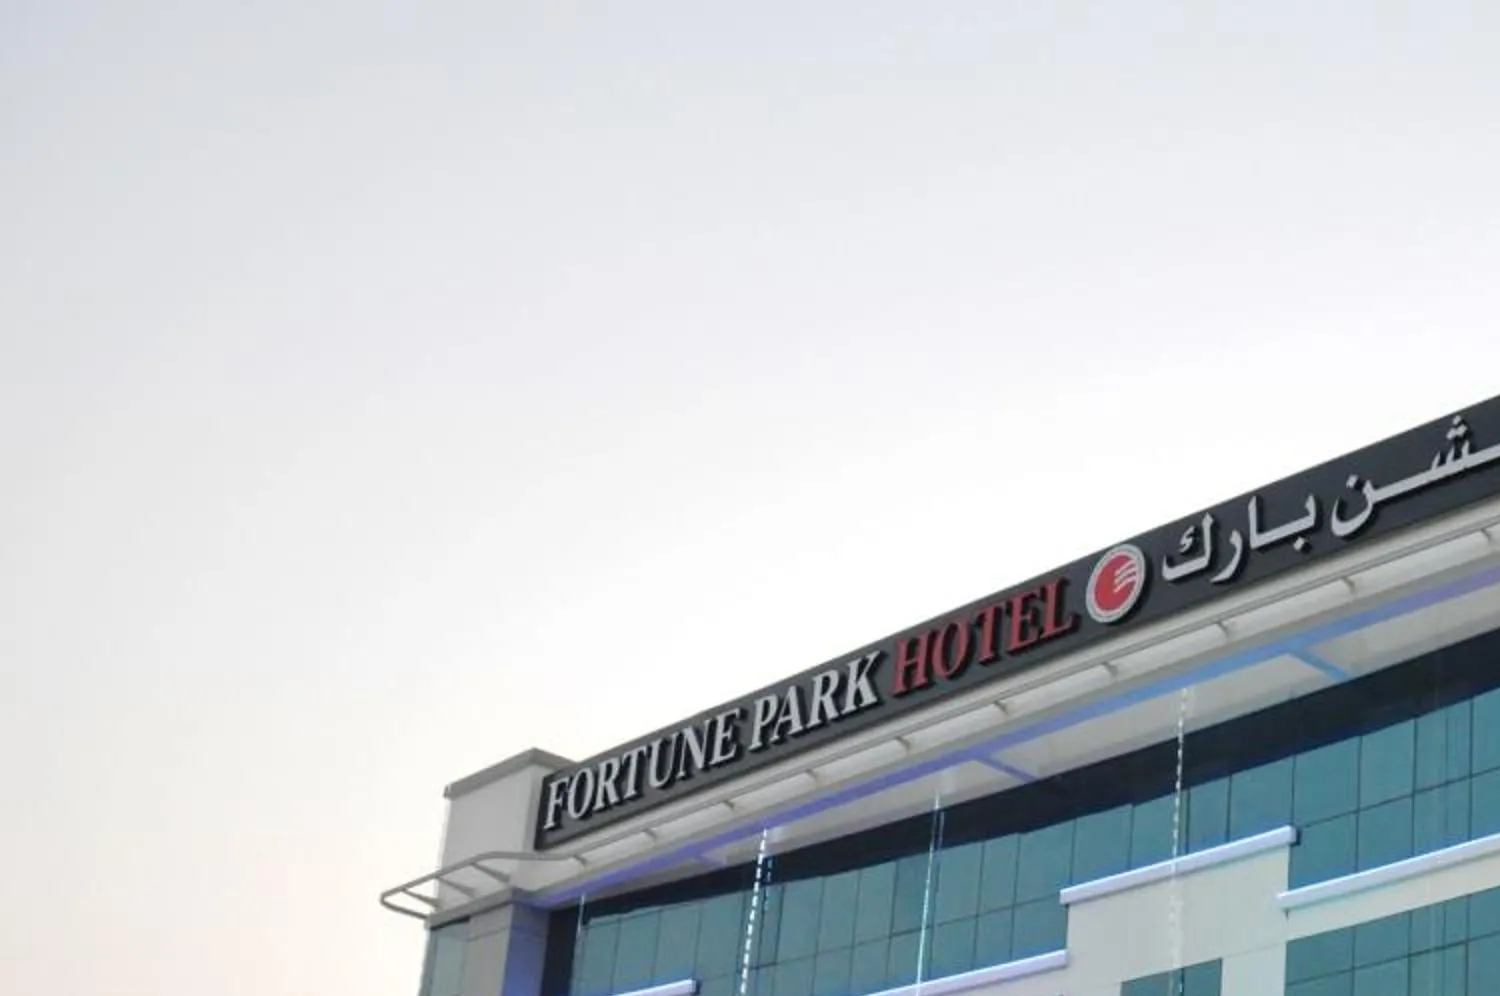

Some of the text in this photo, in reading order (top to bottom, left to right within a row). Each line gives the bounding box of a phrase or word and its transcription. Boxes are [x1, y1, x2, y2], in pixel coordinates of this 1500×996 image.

[1160, 493, 1317, 582] بارك
[542, 577, 1078, 831] FORTUNE PARK HOTEL
